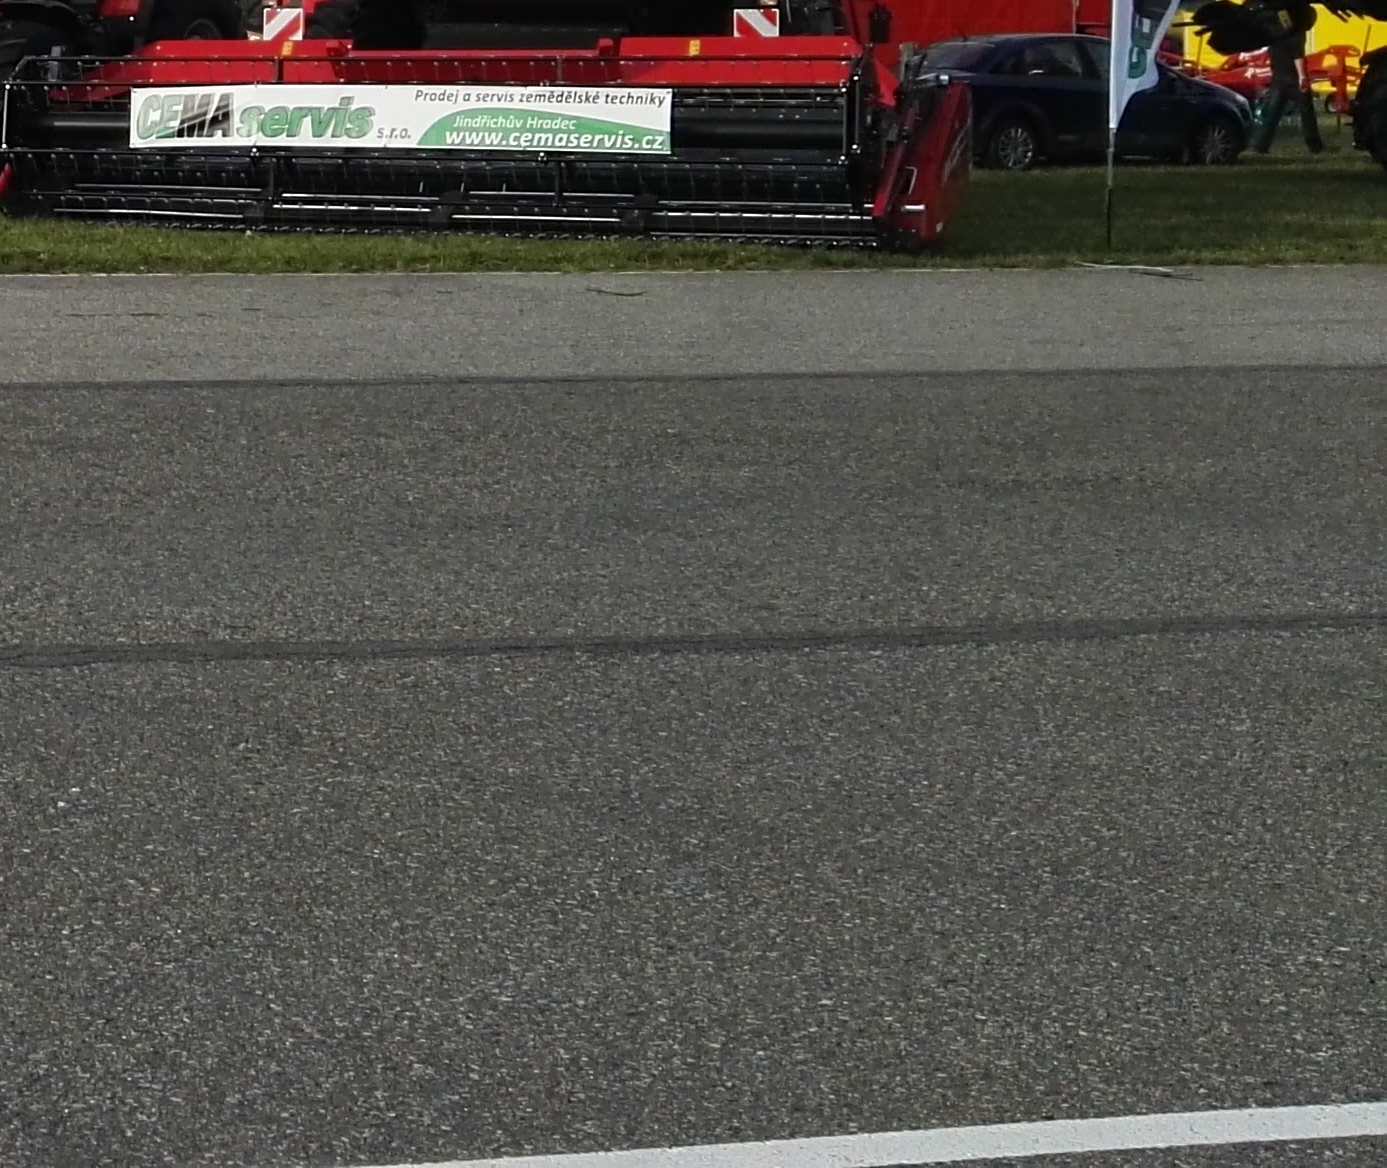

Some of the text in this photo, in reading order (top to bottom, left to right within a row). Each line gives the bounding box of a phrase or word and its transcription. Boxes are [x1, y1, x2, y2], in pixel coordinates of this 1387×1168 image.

[414, 89, 666, 107] Prodej a servis zemědělské techniky
[453, 115, 577, 129] Jindřichův Hradec
[377, 126, 411, 139] s.r.o.
[445, 130, 664, 150] www.cemaservis.cz
